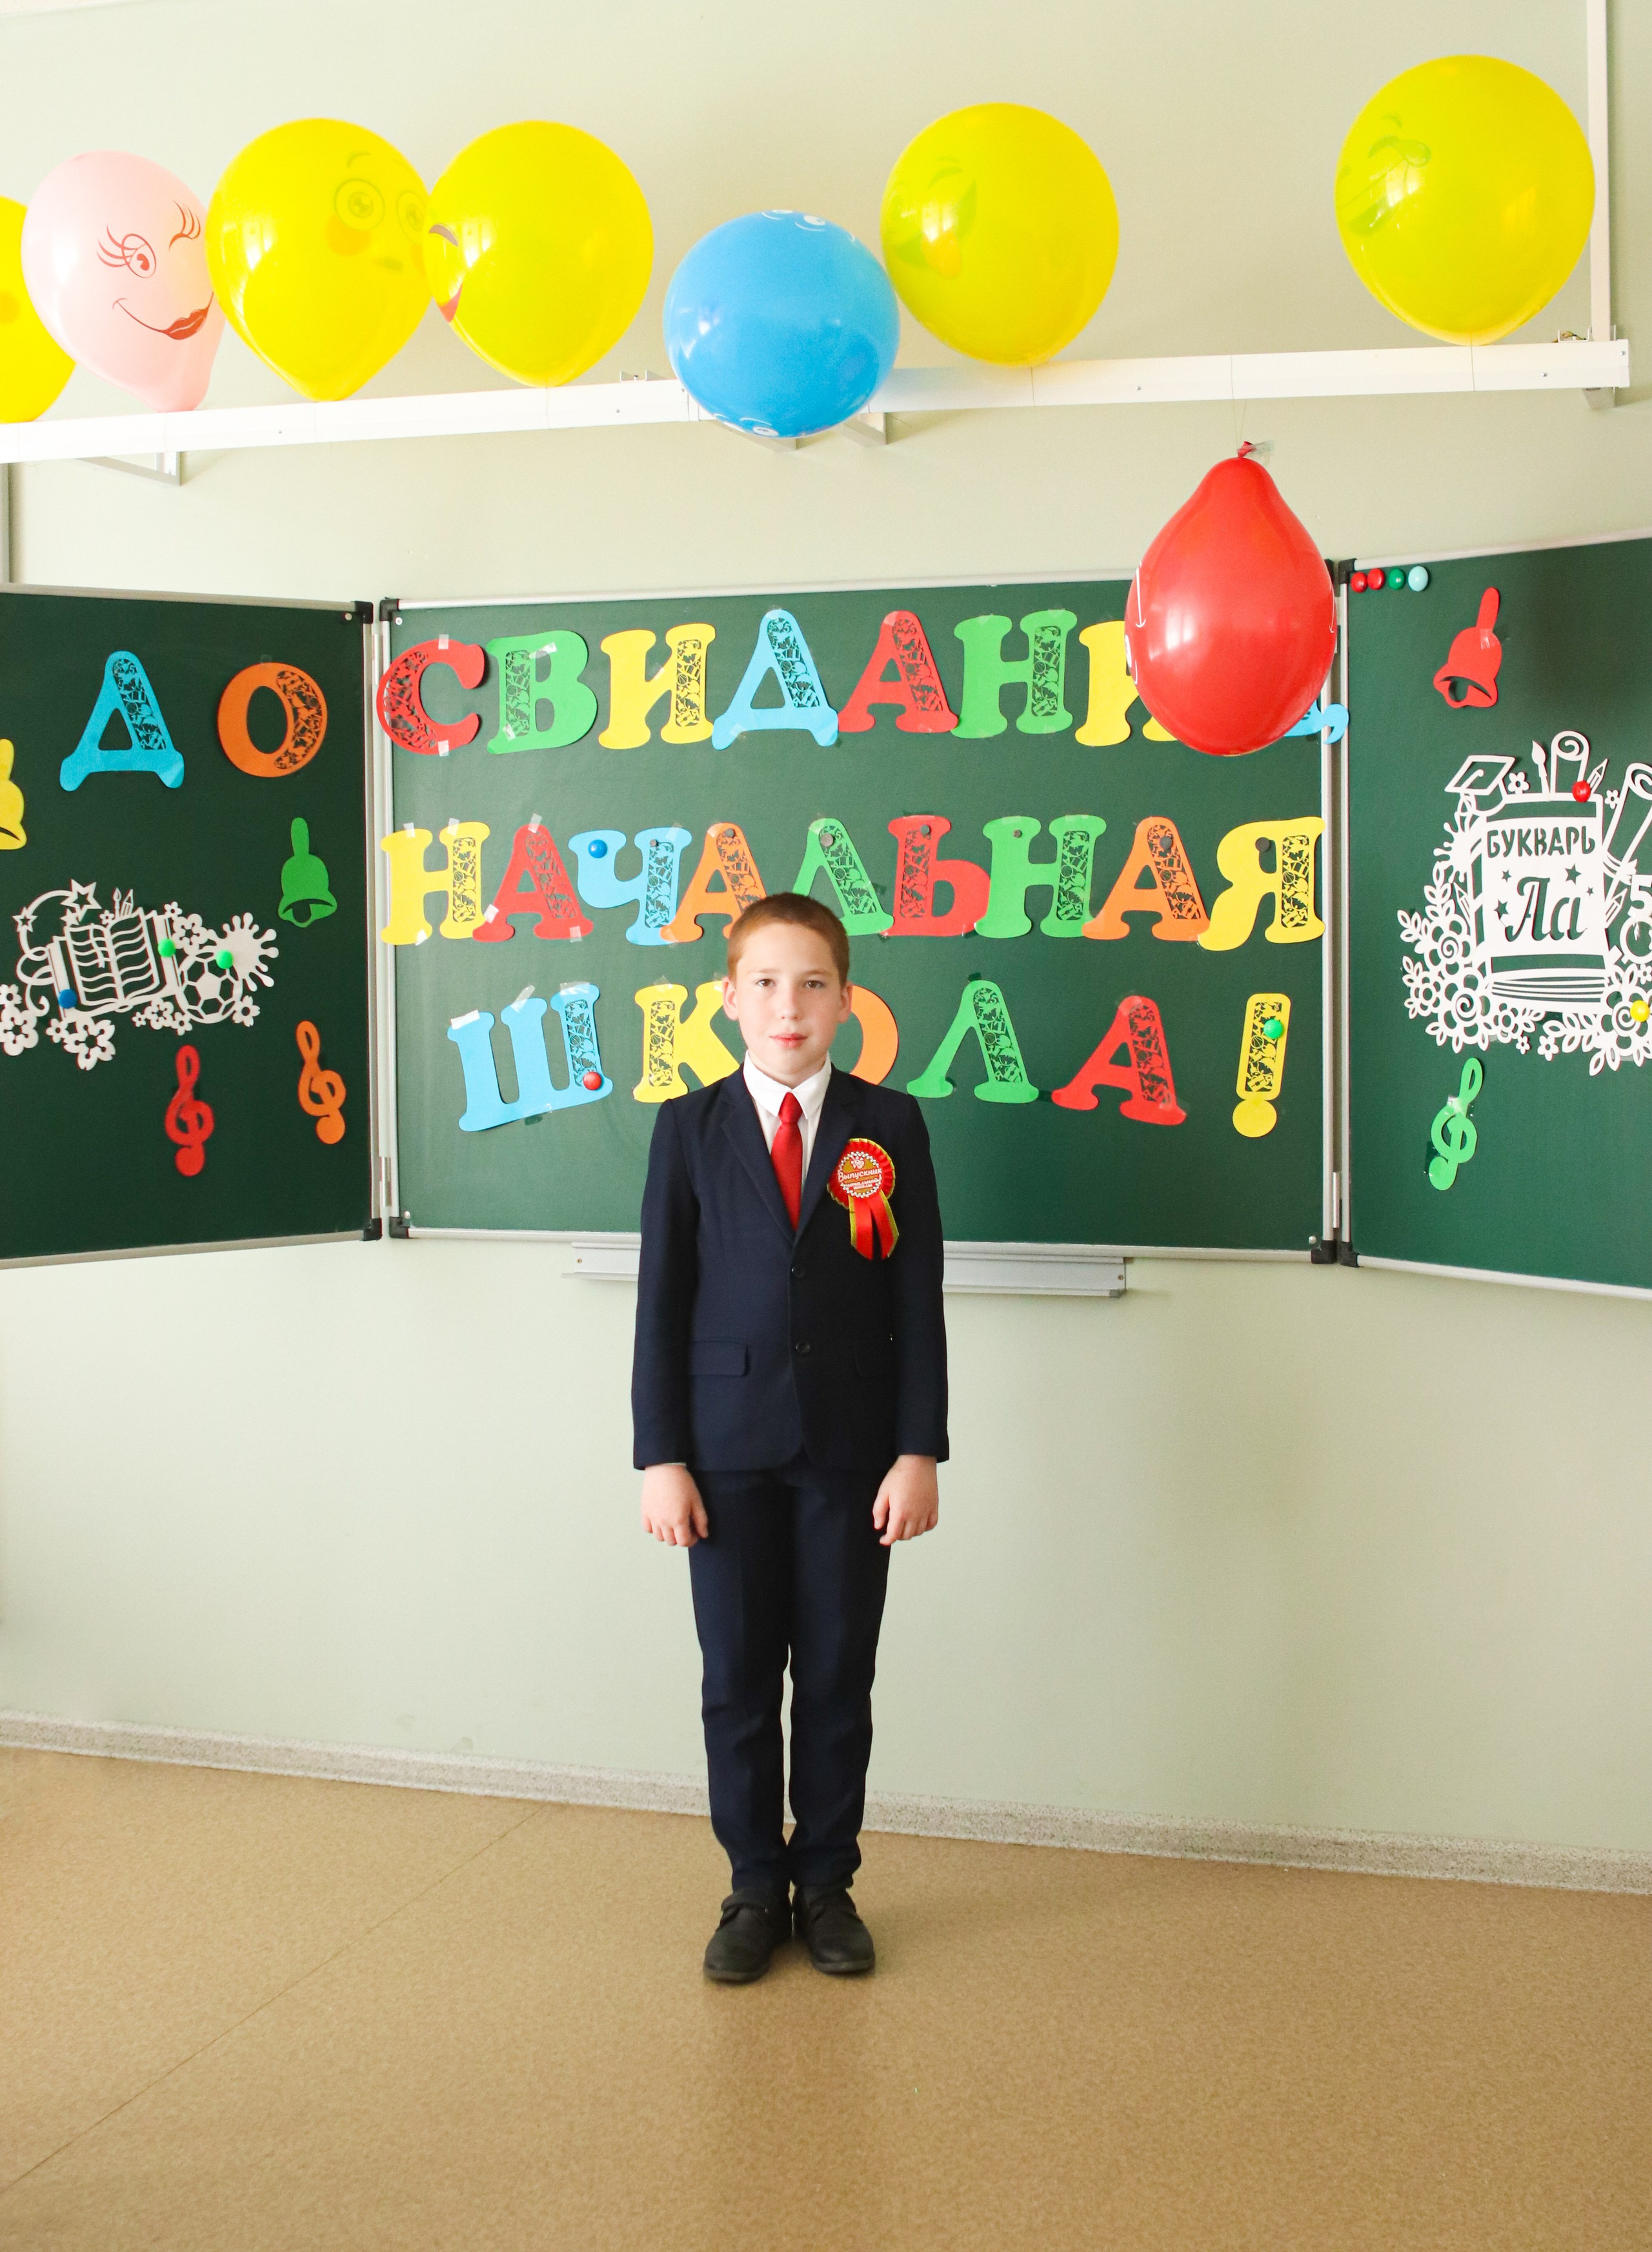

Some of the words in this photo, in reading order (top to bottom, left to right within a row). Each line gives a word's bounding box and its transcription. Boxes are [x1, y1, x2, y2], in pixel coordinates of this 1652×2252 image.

[60, 651, 328, 791] ДО
[380, 816, 1325, 951] НАЧАЛЬНАЯ
[1487, 826, 1596, 858] БУКВАРЬ
[838, 1168, 882, 1182] Выпускник
